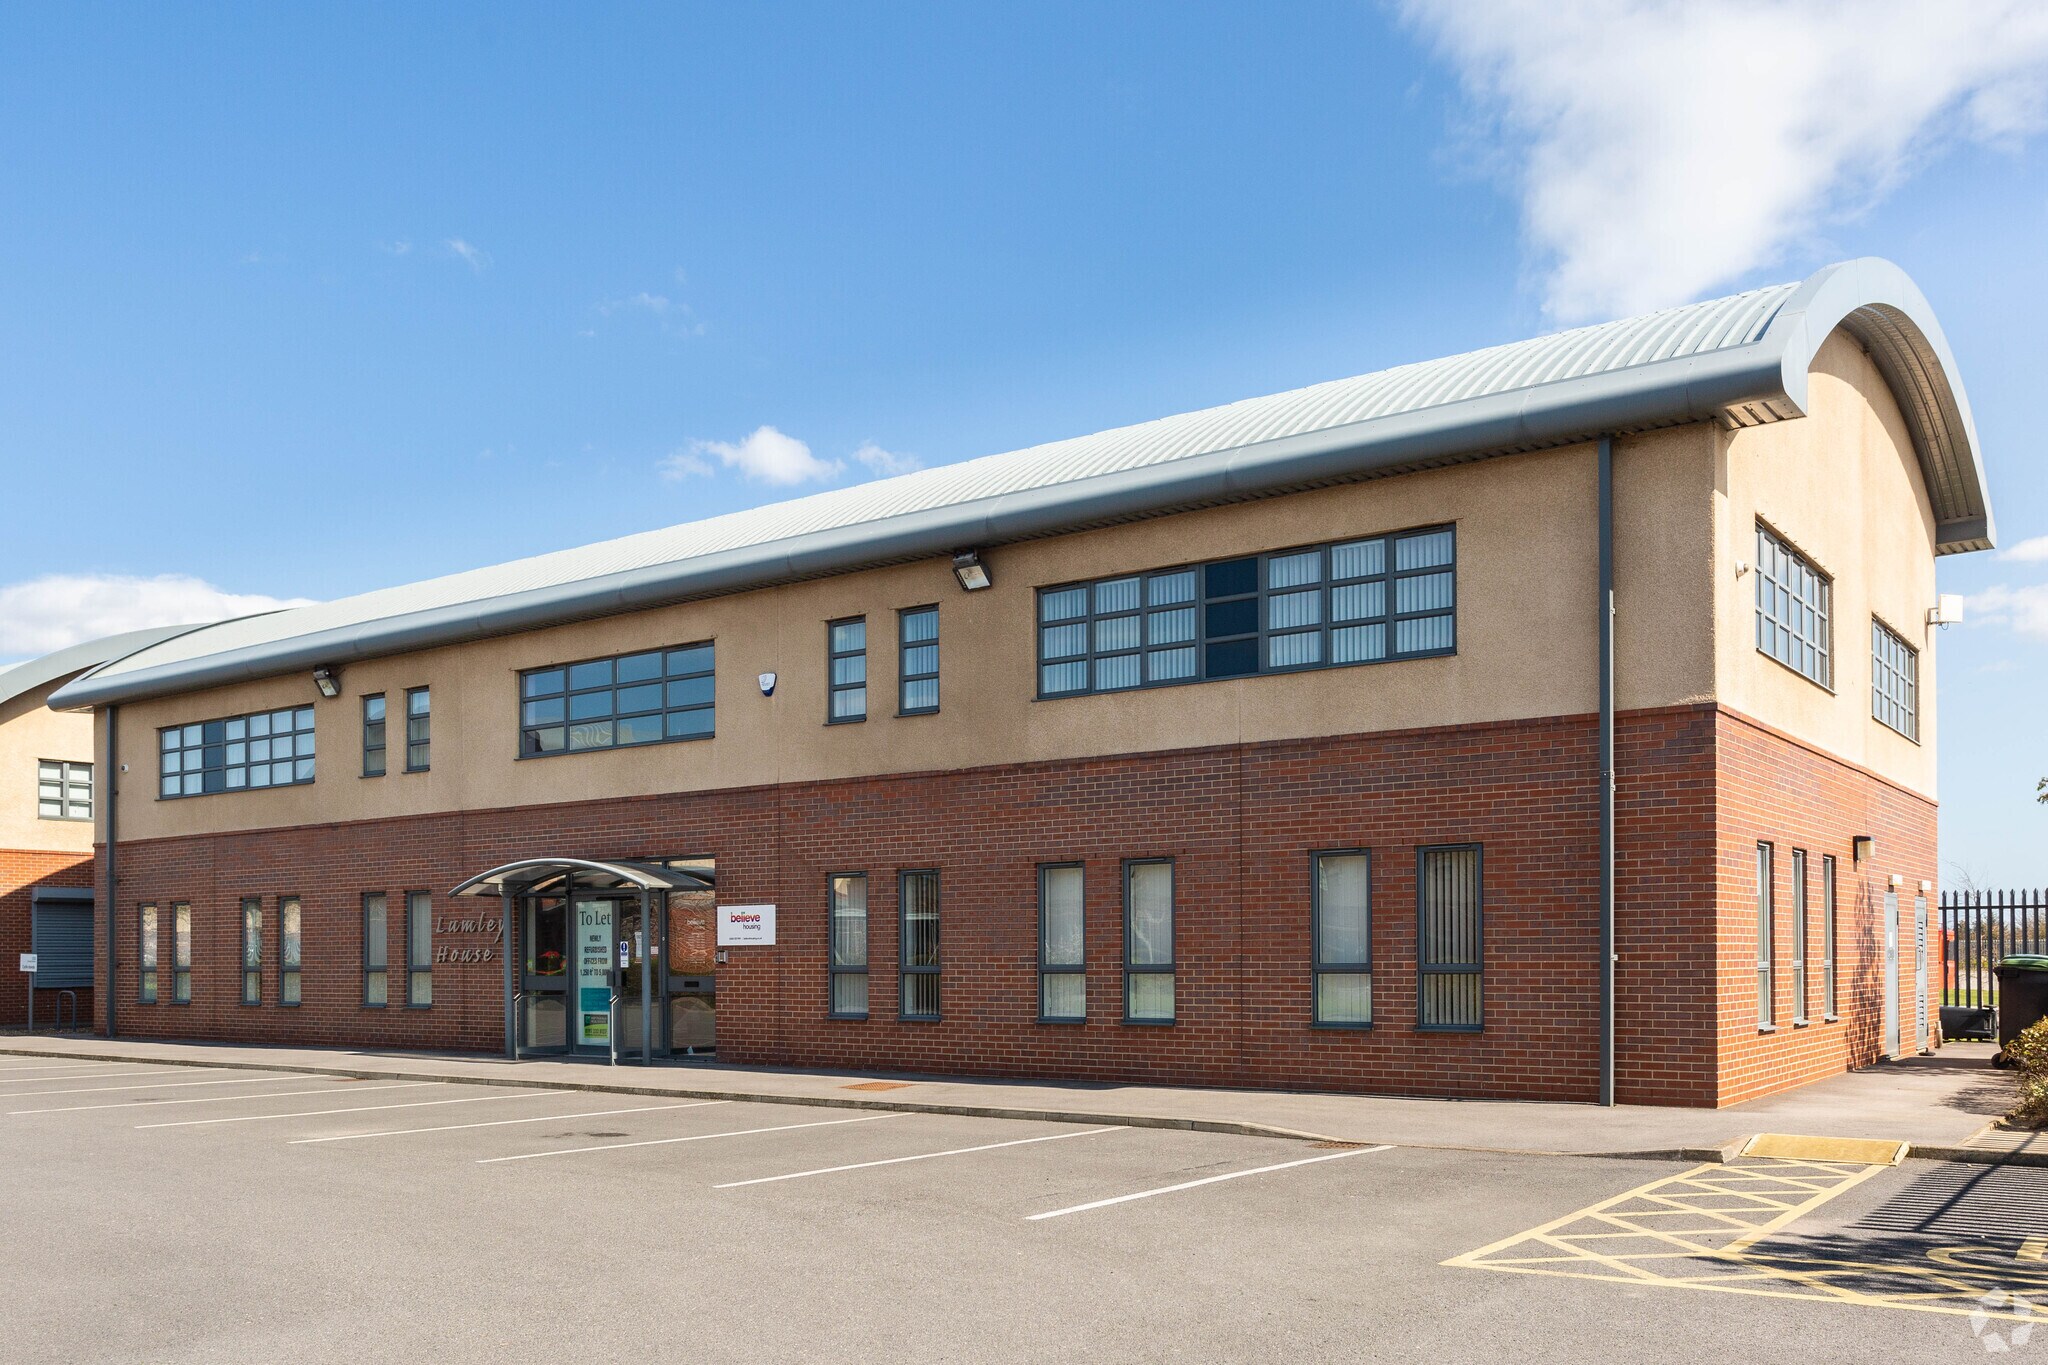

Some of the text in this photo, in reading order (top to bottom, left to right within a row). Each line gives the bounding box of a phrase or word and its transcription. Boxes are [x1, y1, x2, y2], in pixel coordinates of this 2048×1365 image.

[579, 911, 611, 926] To Let
[731, 911, 760, 922] believe
[436, 911, 504, 944] Lumley
[743, 923, 760, 931] housing
[436, 945, 493, 963] House
